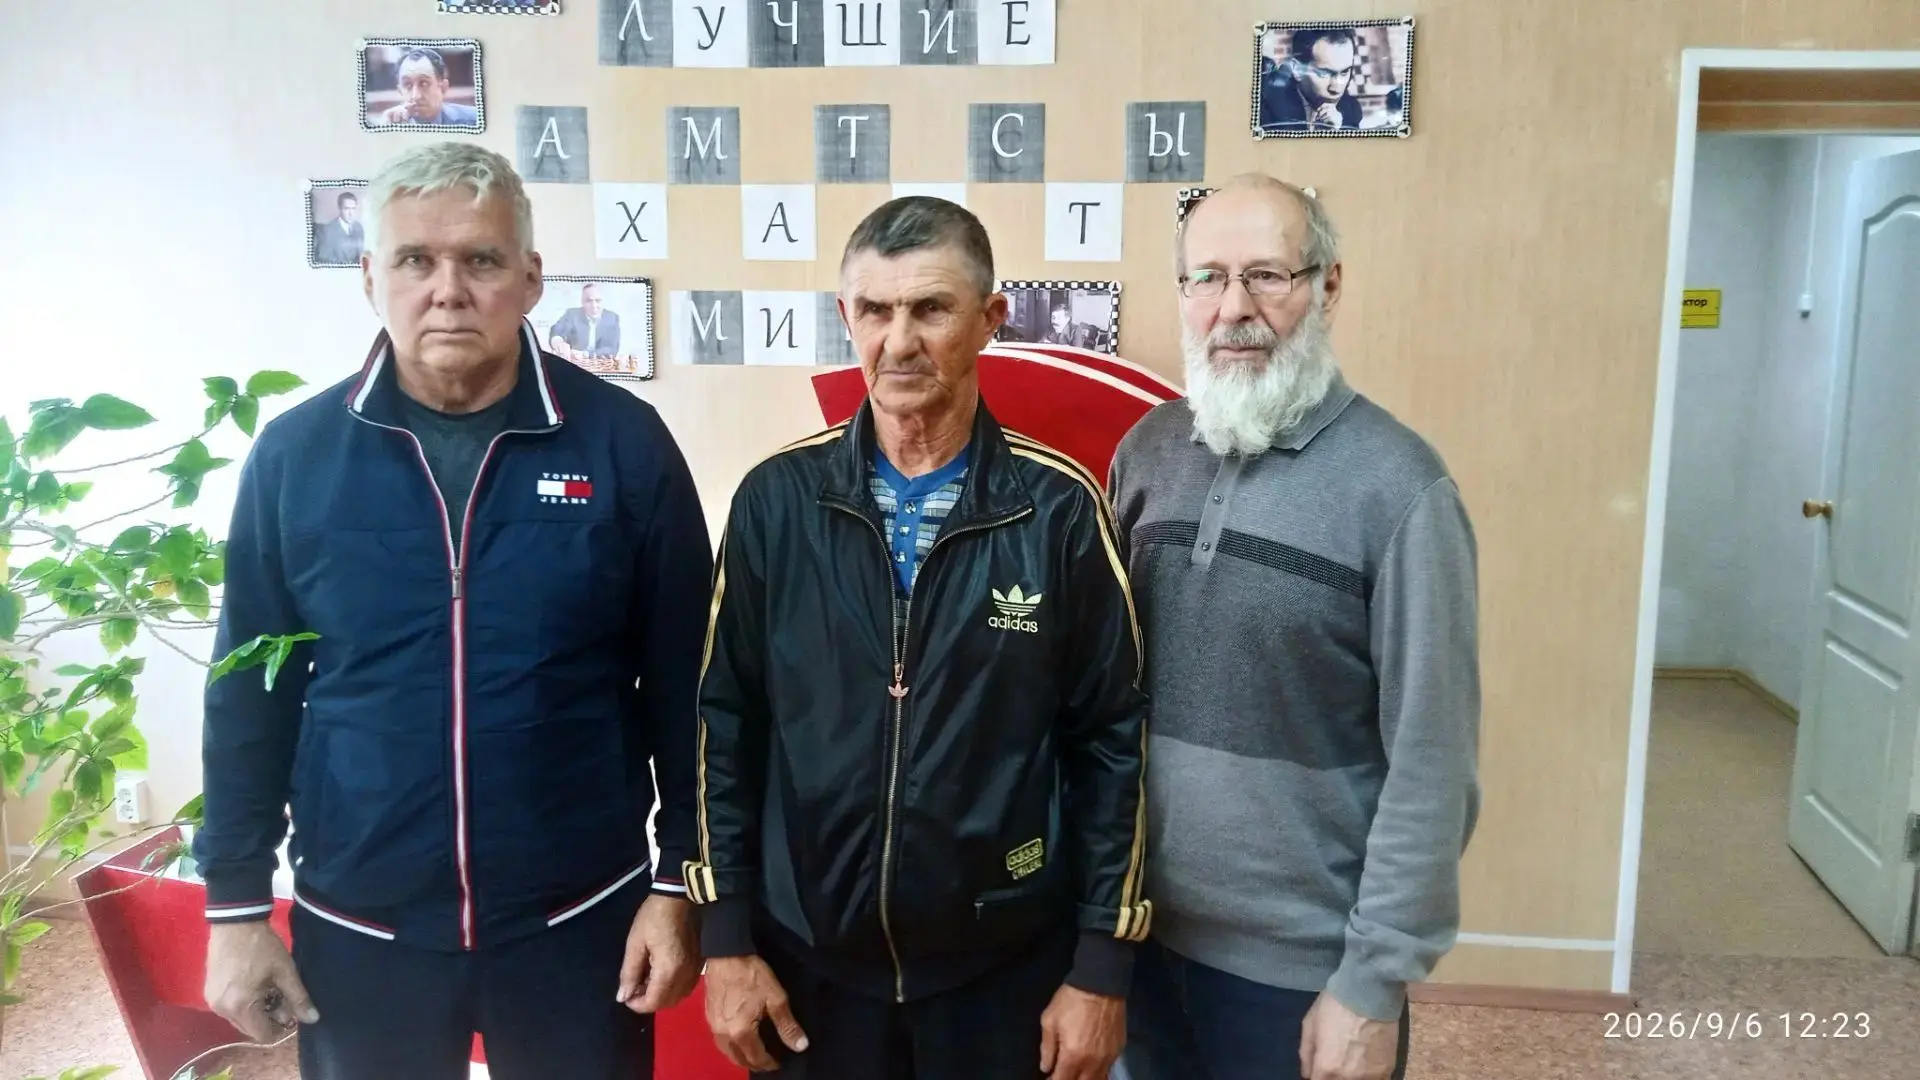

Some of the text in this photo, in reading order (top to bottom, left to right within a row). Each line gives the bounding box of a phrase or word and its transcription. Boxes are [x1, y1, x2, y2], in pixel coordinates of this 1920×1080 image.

[542, 472, 588, 481] TOMMY
[540, 496, 587, 504] JEANS
[988, 615, 1039, 632] adidas
